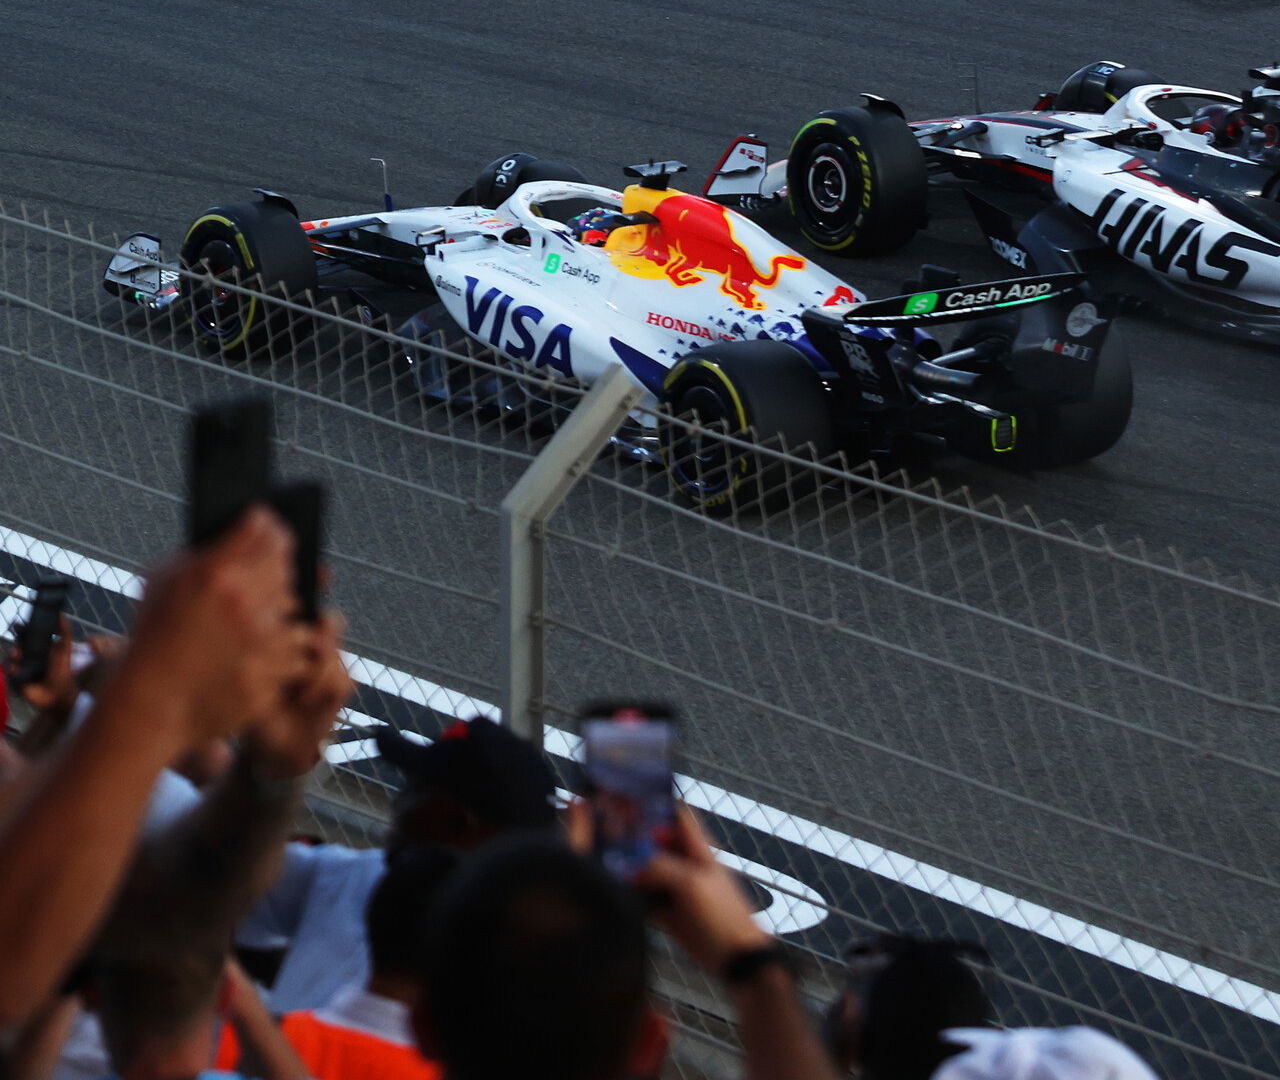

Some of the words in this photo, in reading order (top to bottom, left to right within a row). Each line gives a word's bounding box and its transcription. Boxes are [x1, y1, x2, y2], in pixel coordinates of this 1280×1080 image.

[561, 261, 581, 278] Cash
[582, 267, 601, 285] App
[944, 290, 1002, 309] Cash
[1003, 282, 1053, 303] App
[465, 275, 576, 379] VISA
[645, 312, 715, 341] HONDA
